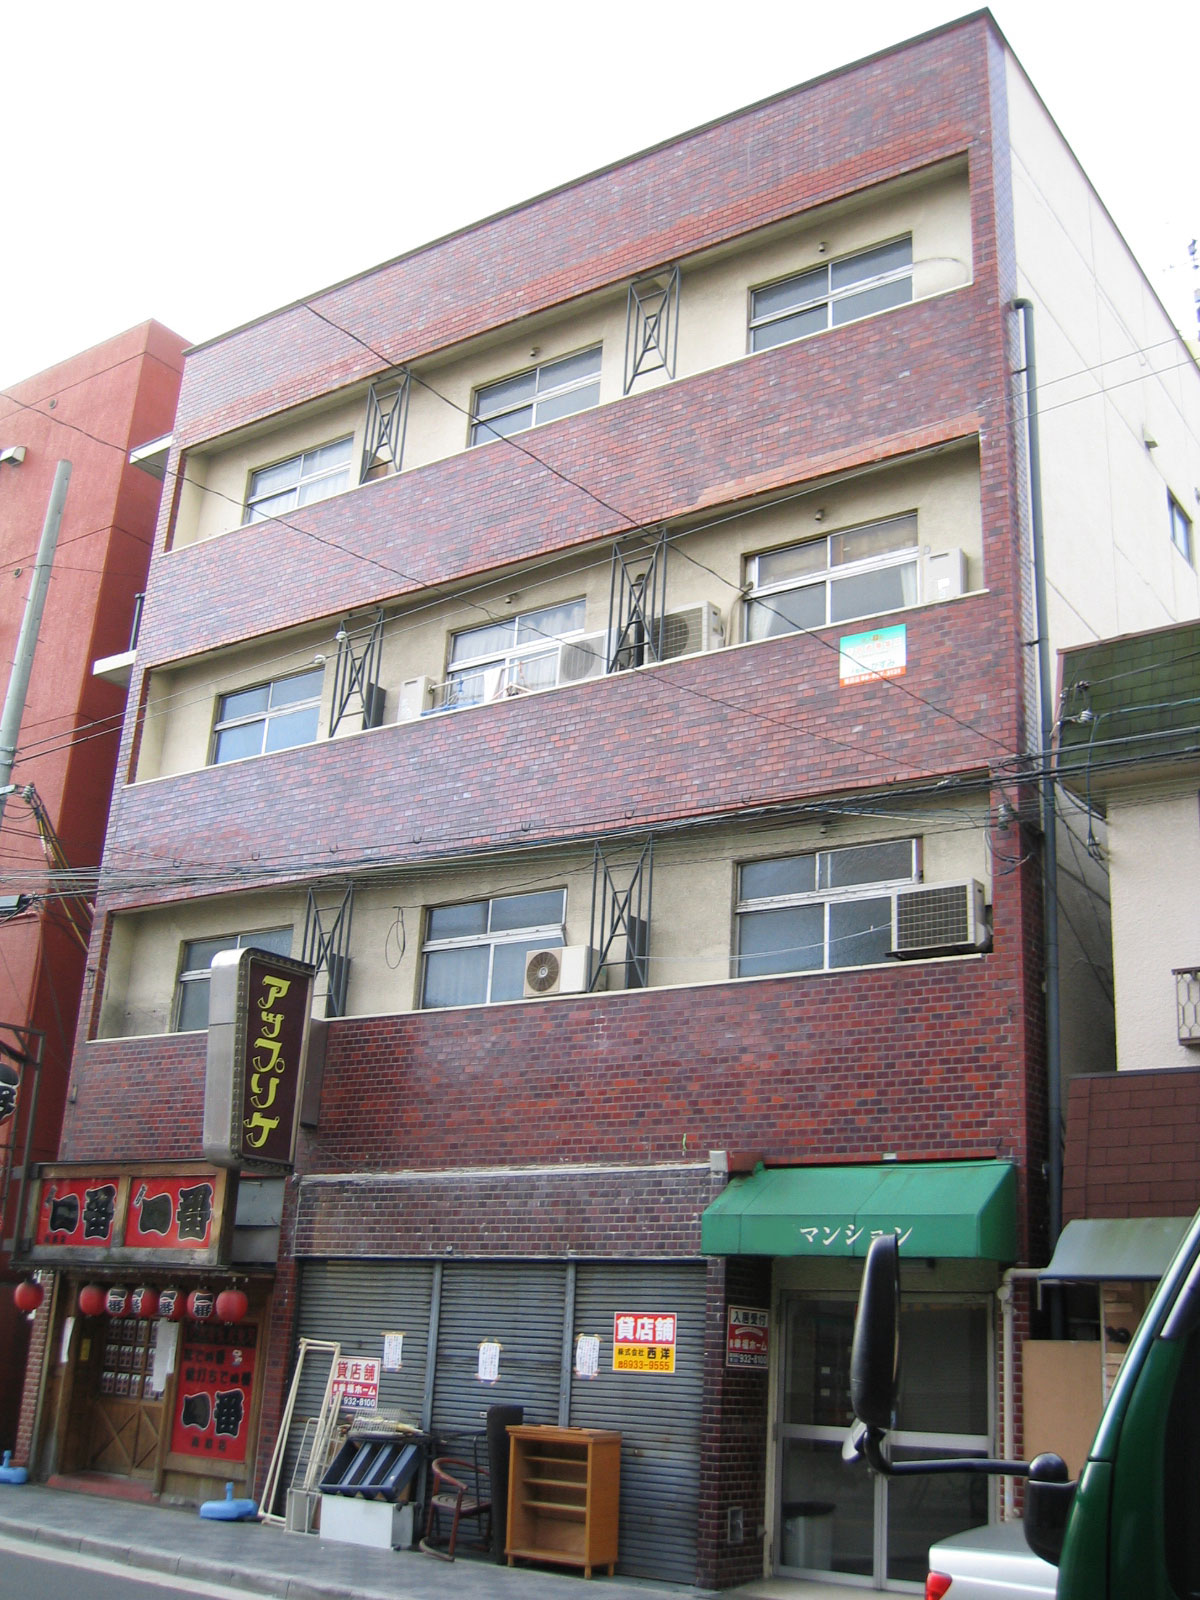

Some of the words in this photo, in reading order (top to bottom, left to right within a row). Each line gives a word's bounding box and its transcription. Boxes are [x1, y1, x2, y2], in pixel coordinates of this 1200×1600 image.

[243, 975, 291, 1148] アップリケ
[139, 1182, 214, 1242] 一番
[193, 1292, 215, 1318] 一番
[617, 1316, 674, 1342] 貸店舗
[624, 1360, 670, 1370] 6933-9555
[647, 1347, 671, 1360] 西洋
[336, 1361, 376, 1382] 貸店舗
